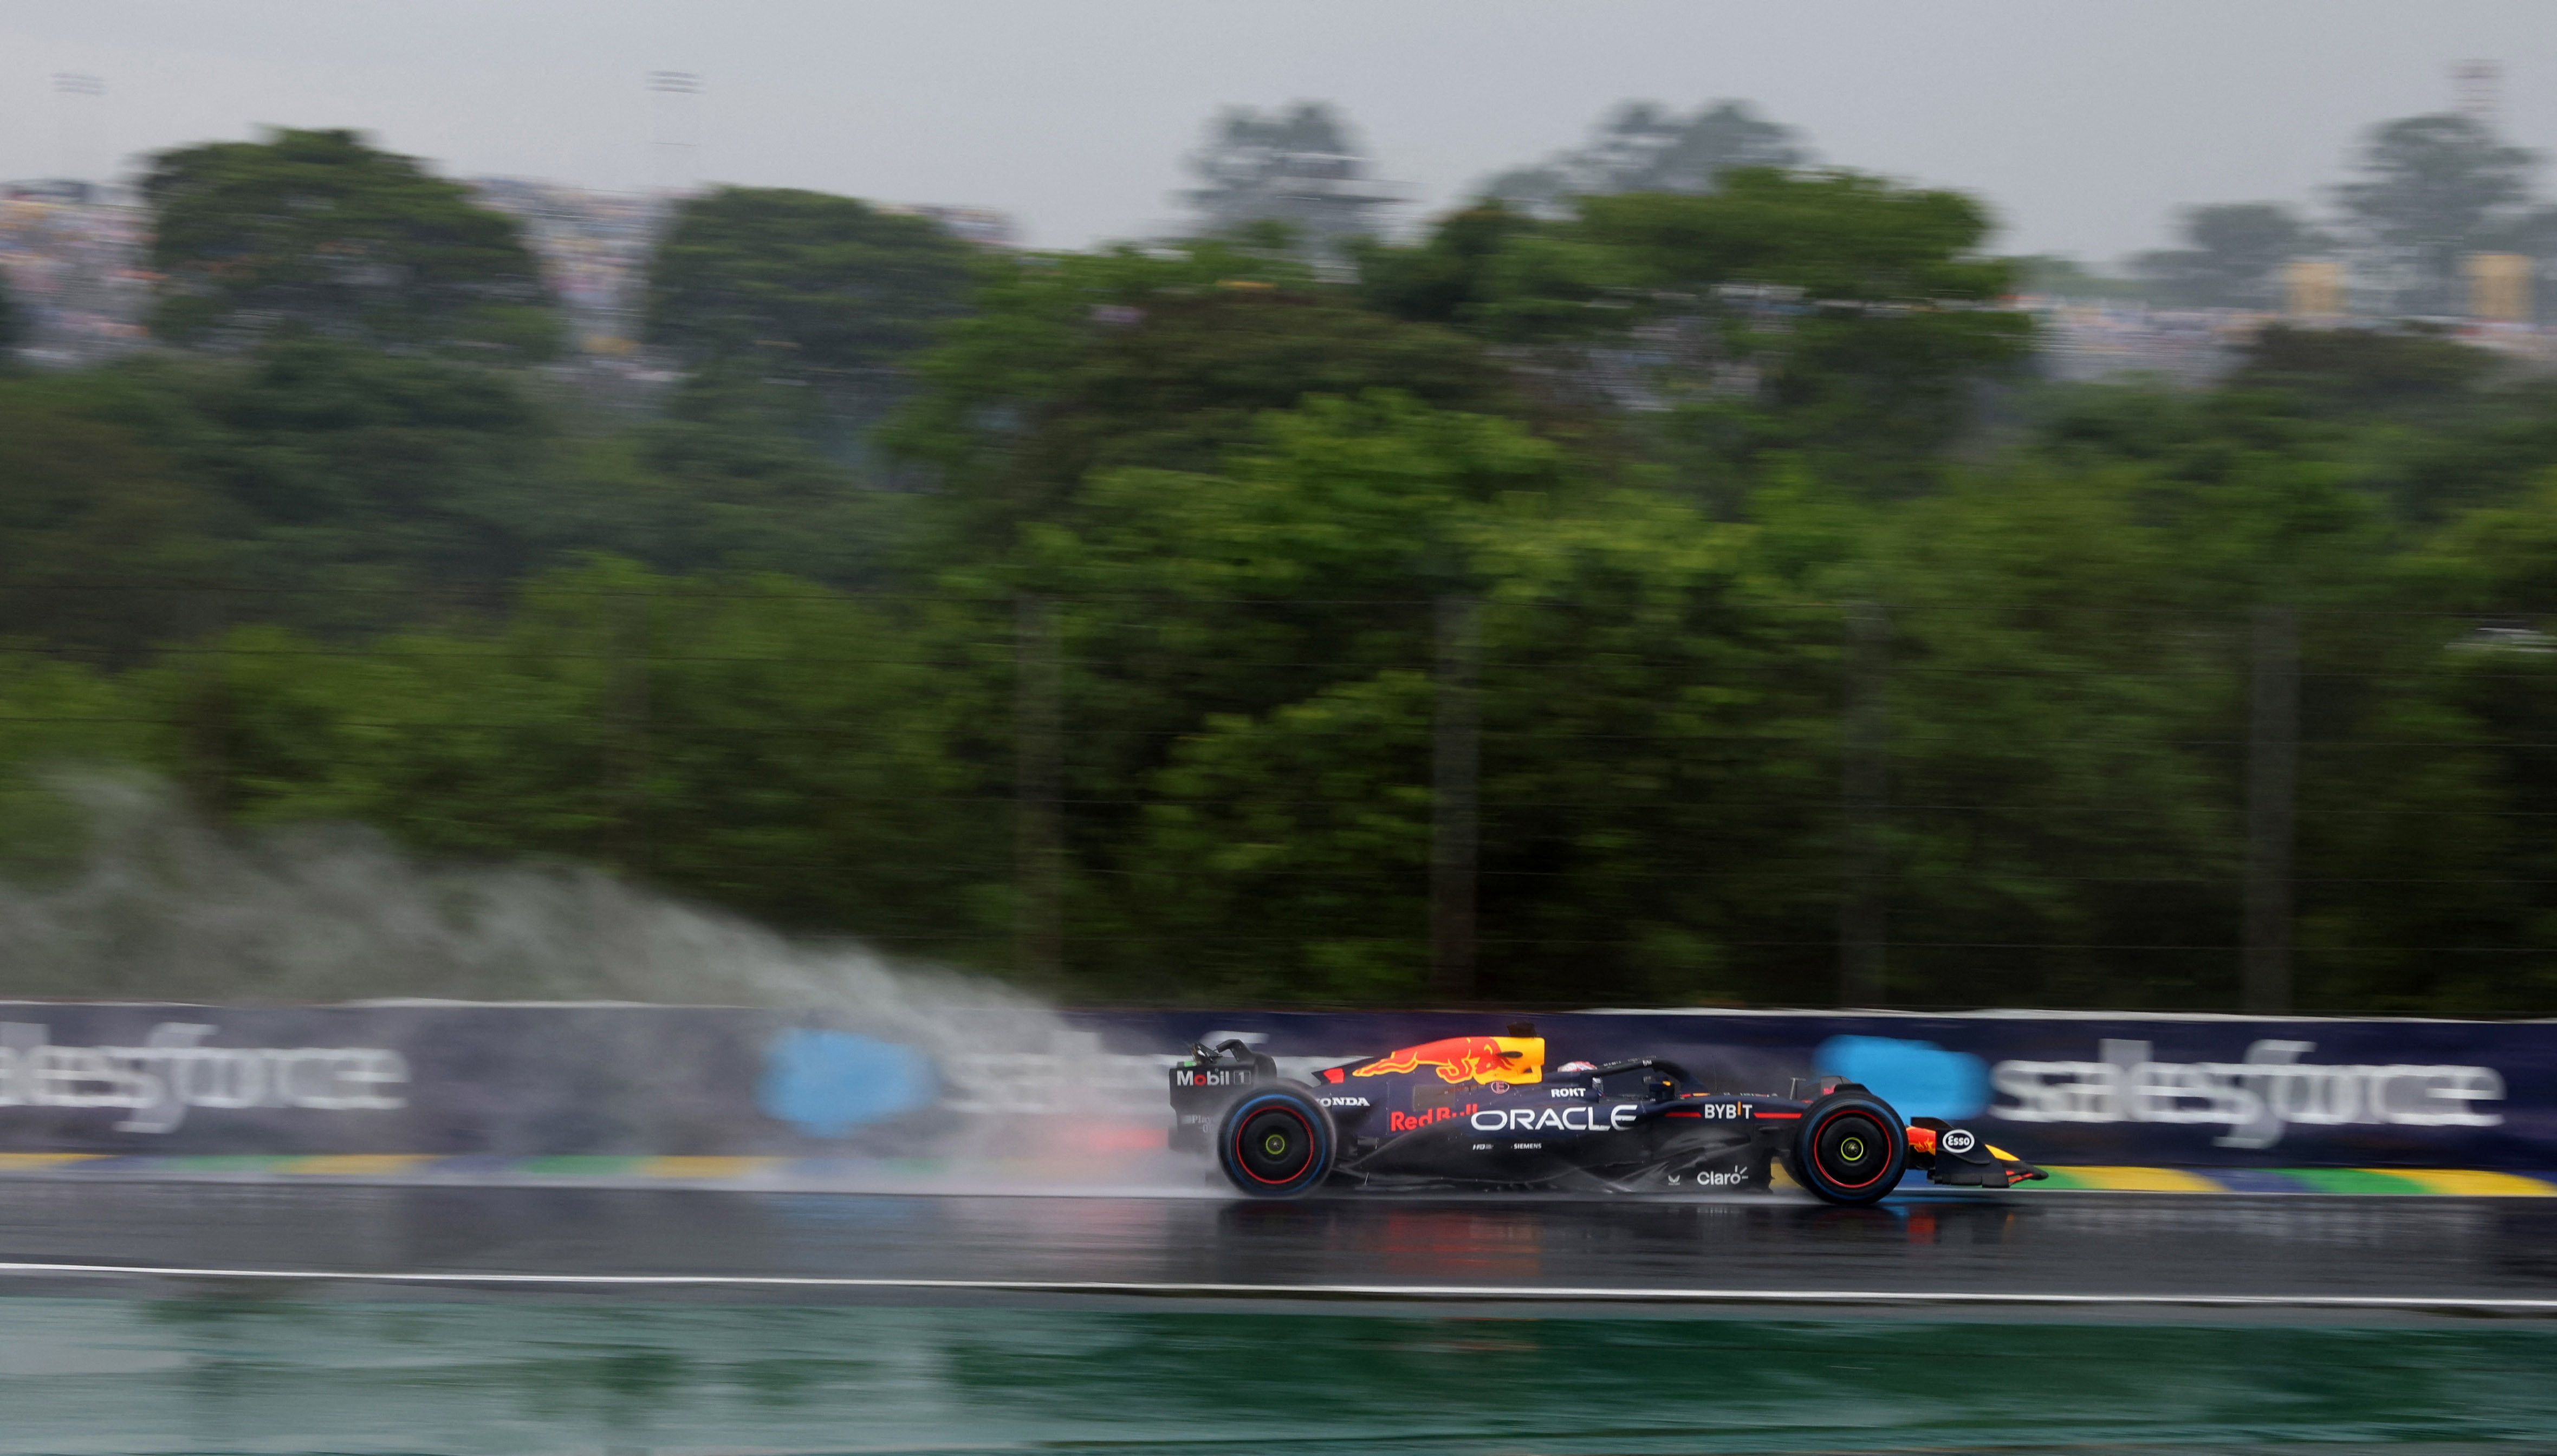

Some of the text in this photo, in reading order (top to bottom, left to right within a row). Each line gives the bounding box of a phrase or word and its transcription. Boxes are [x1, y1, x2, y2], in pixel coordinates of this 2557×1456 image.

[1177, 1070, 1230, 1086] Mobil
[1551, 1088, 1586, 1098] ROKT
[1990, 1038, 2506, 1148] salesforce
[1315, 1096, 1371, 1107] ONDA
[1470, 1104, 1638, 1132] ORACLE
[1704, 1101, 1753, 1120] BYBIT
[1390, 1108, 1434, 1132] Red
[1948, 1135, 1970, 1146] Esso
[1696, 1171, 1741, 1186] Claro
